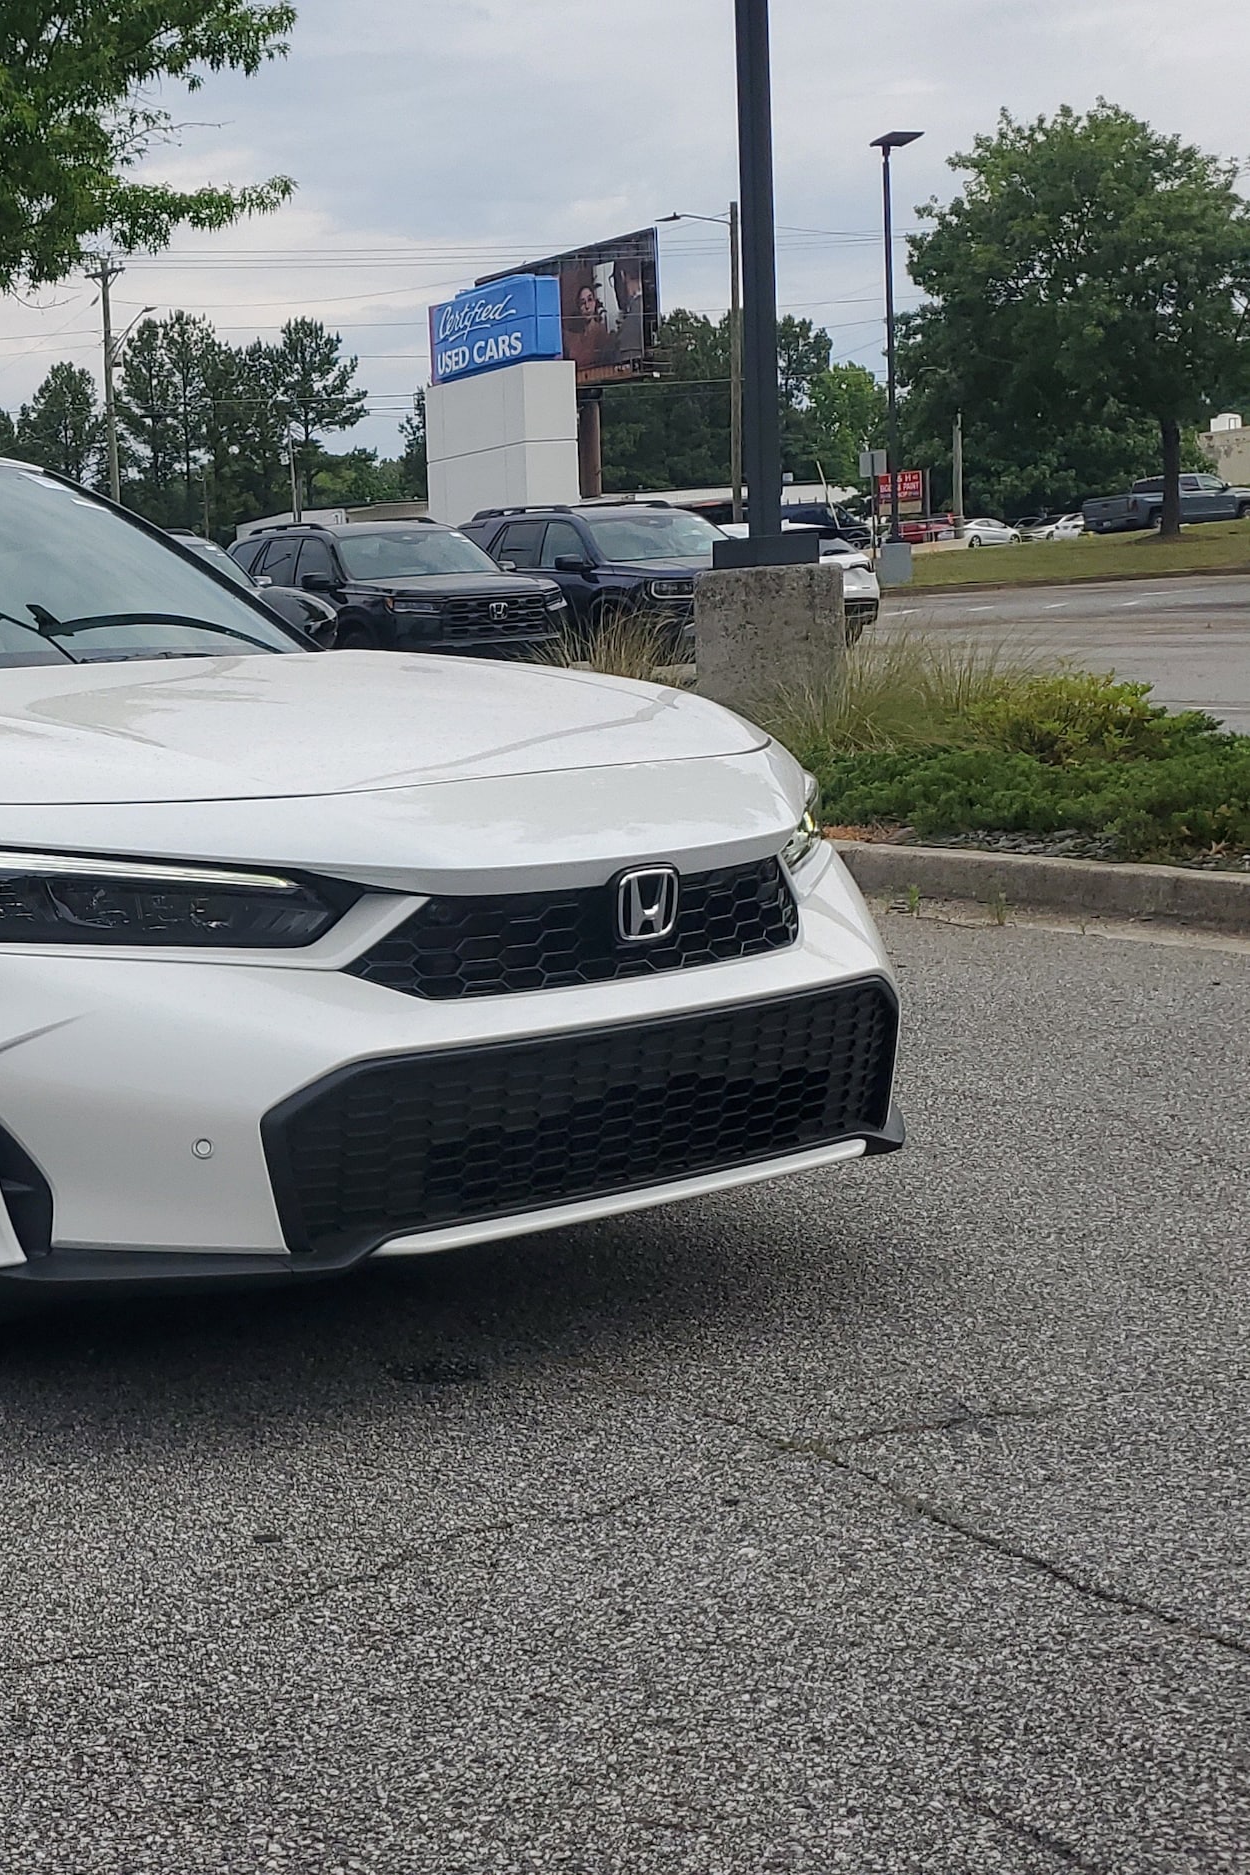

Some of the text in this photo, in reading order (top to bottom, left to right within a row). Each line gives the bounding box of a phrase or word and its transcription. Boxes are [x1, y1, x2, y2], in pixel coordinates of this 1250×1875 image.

[439, 295, 517, 341] Certified
[437, 332, 522, 375] USED CARS
